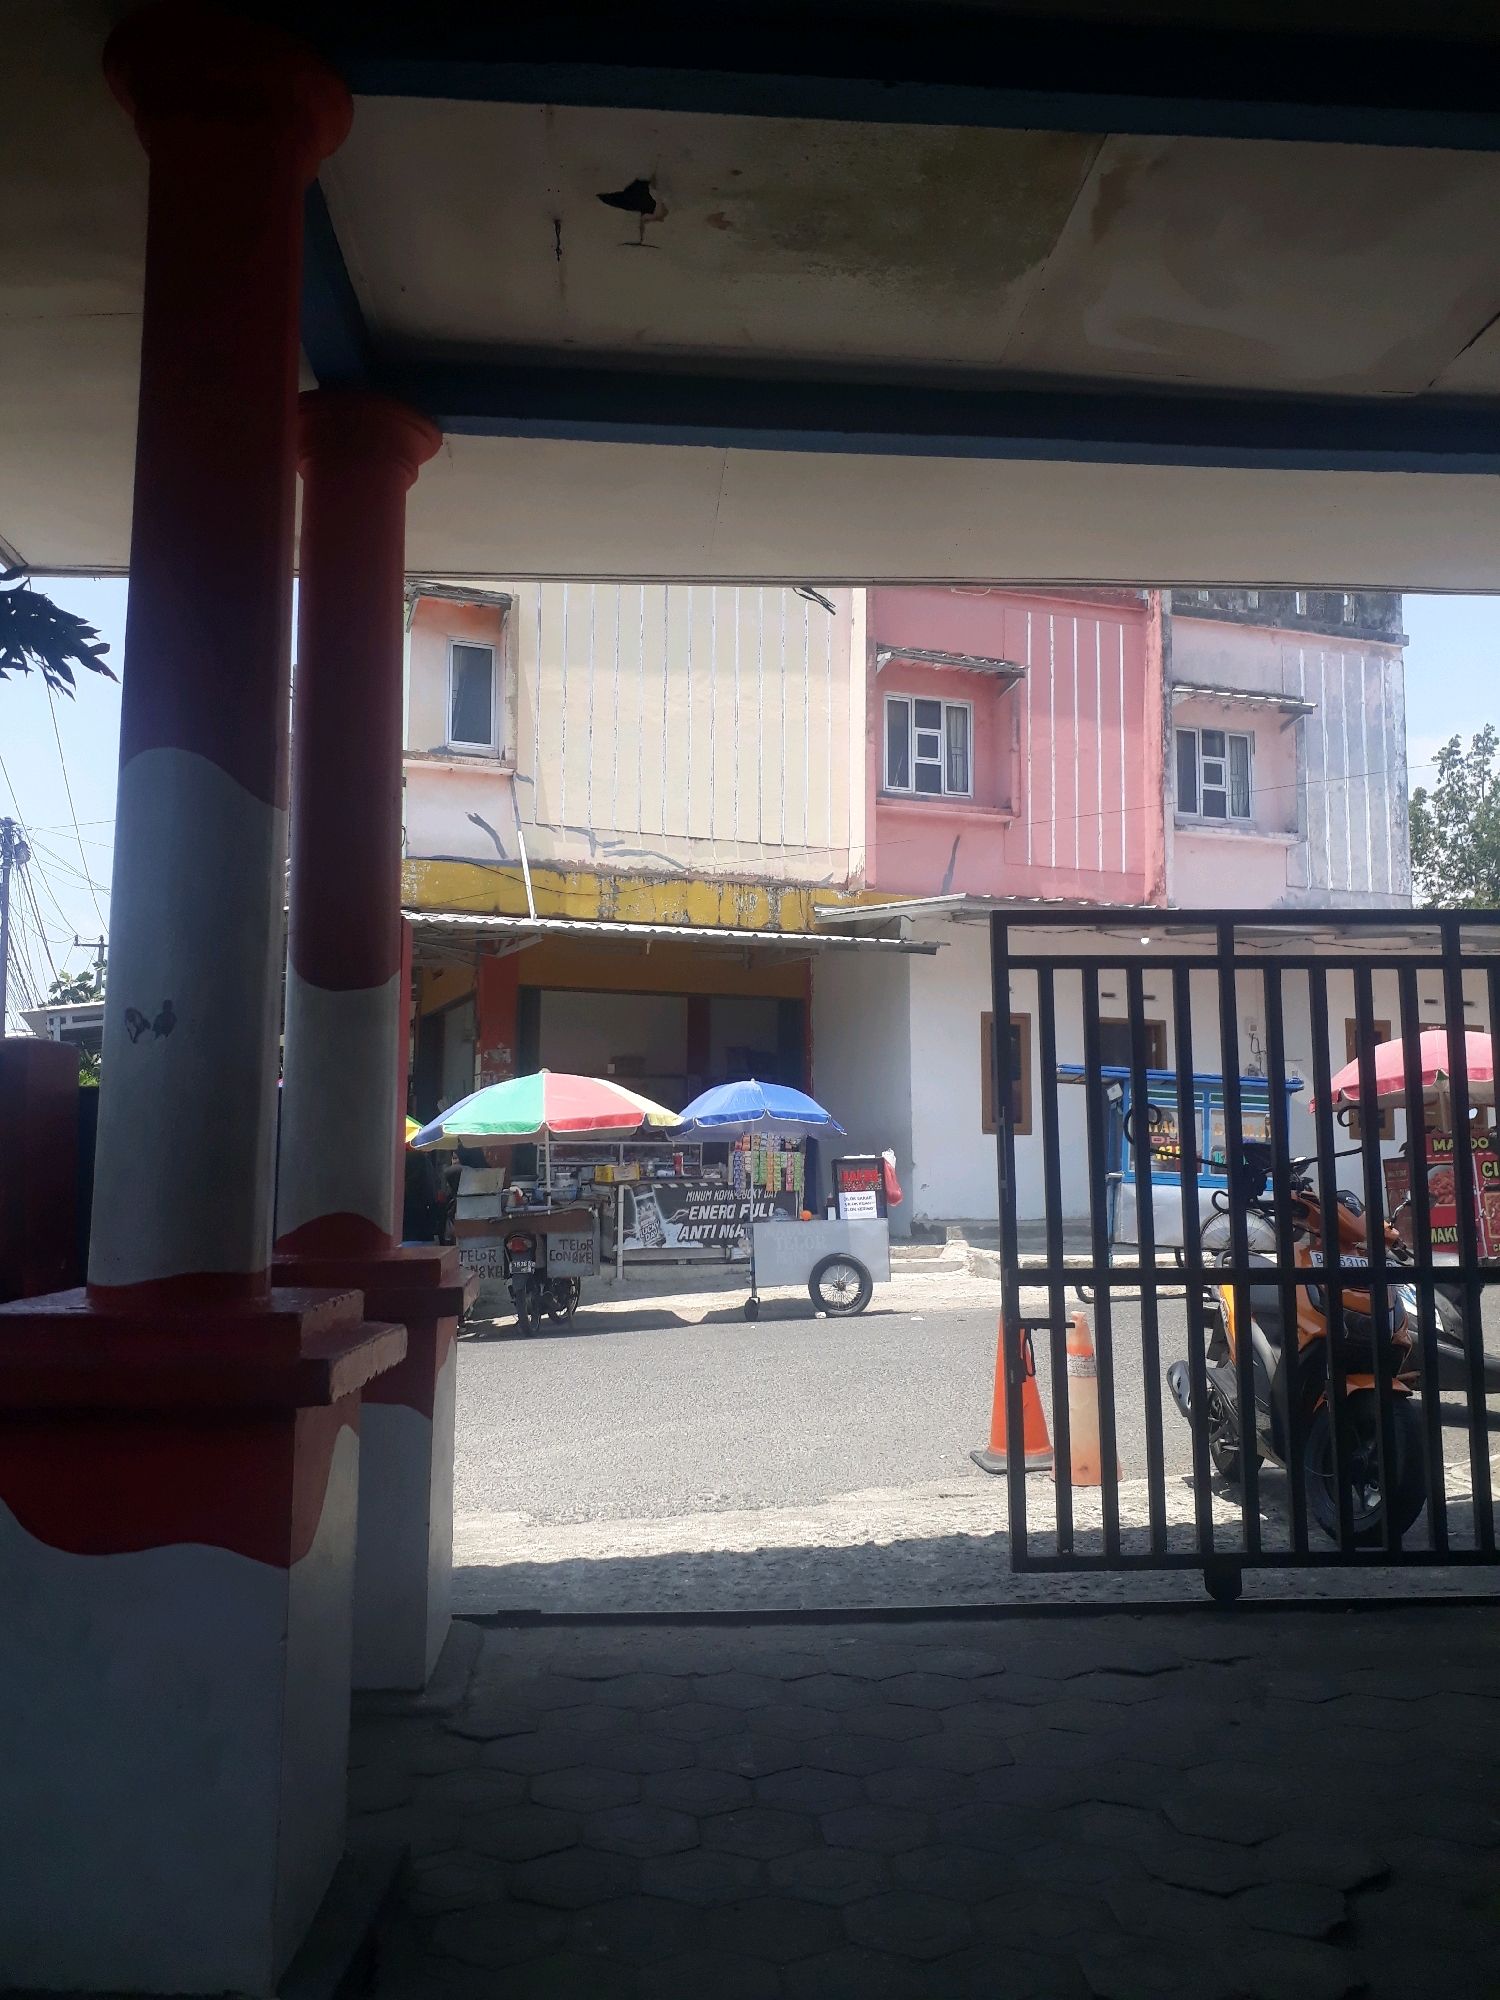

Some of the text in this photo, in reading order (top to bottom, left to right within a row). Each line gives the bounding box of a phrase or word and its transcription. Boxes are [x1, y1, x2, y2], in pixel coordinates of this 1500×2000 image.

[686, 1191, 712, 1202] MINUM
[641, 1220, 660, 1238] LUCKY
[678, 1224, 717, 1241] ANTI
